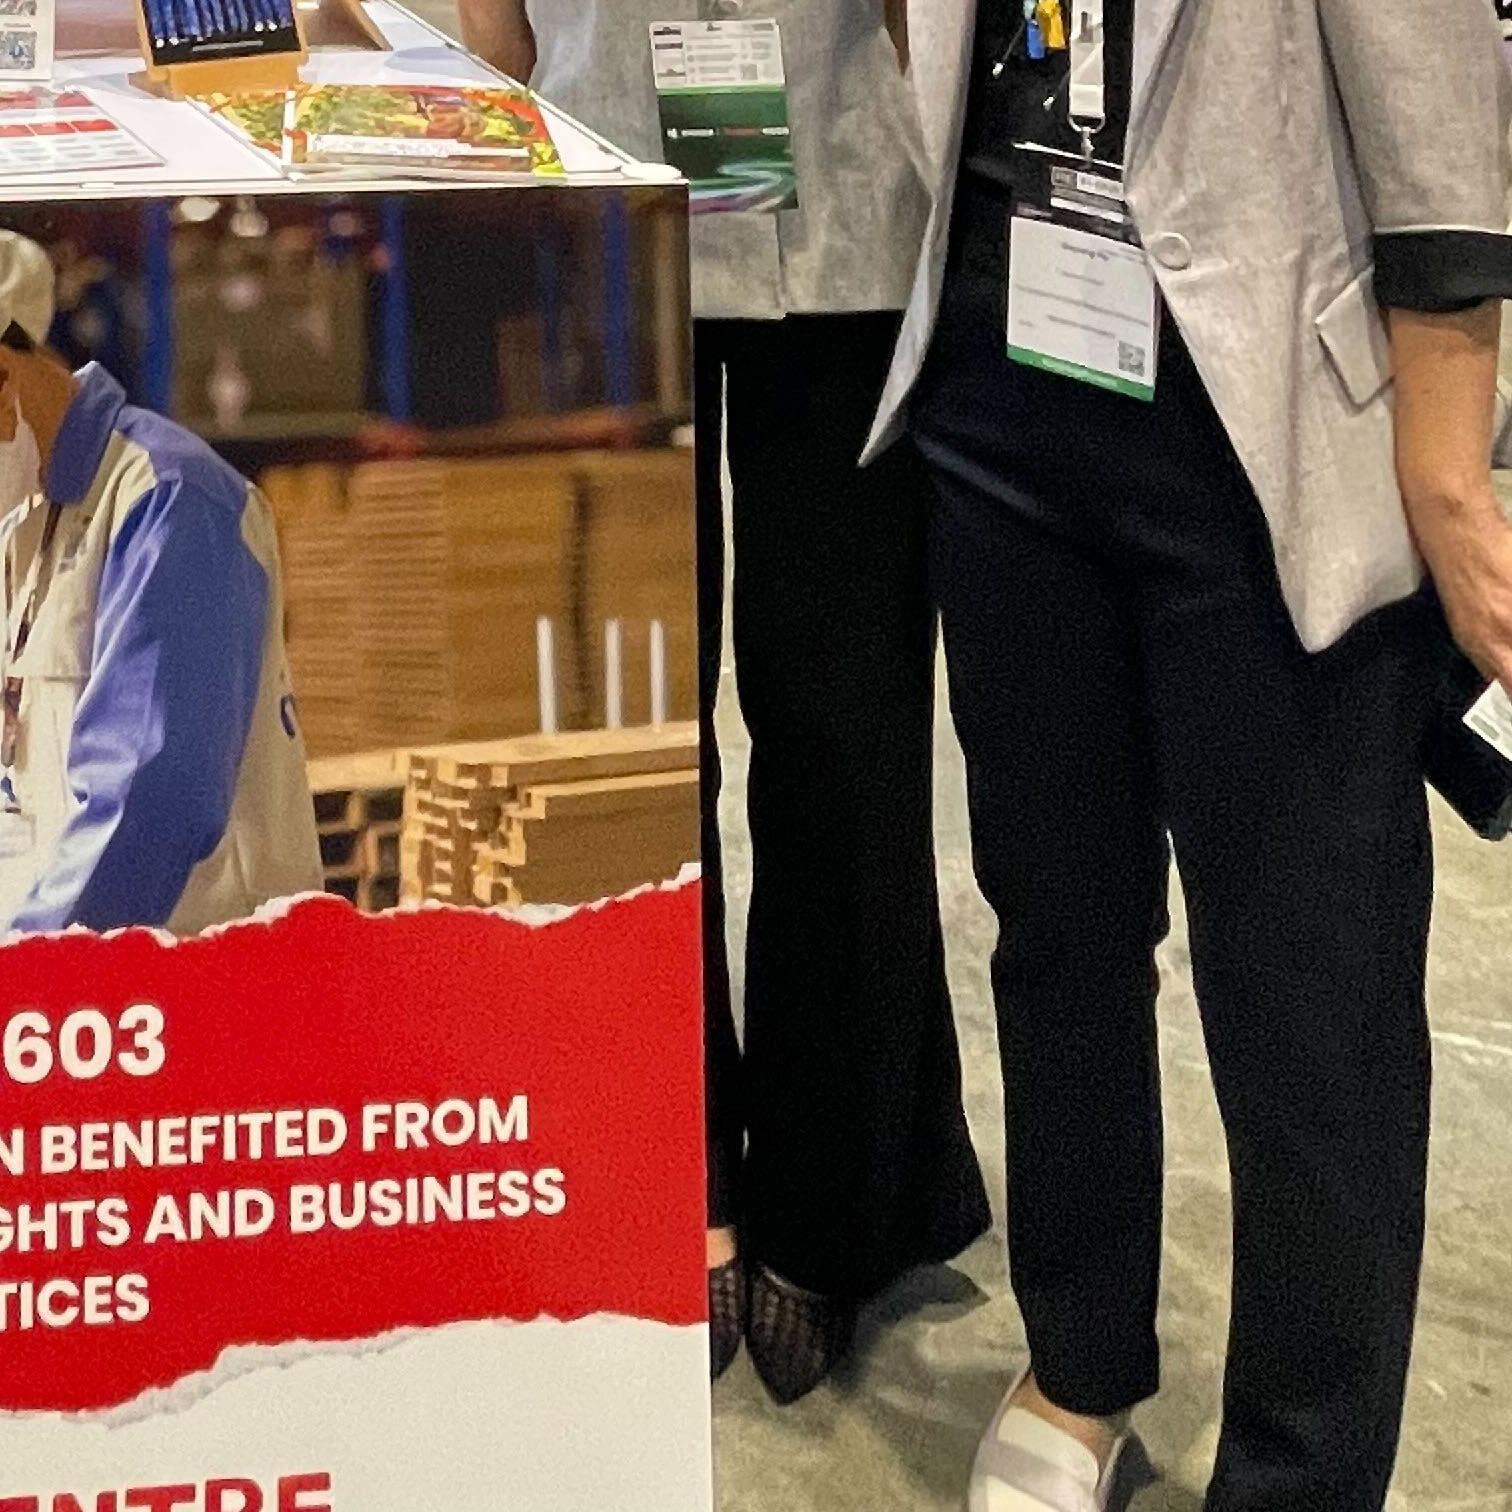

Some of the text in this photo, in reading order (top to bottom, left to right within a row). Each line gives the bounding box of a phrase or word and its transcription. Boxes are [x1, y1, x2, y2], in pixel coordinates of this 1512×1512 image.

[40, 1107, 348, 1174] BENEFITED
[362, 1094, 528, 1152] FROM
[143, 1188, 275, 1244] AND
[289, 1167, 566, 1234] BUSINESS
